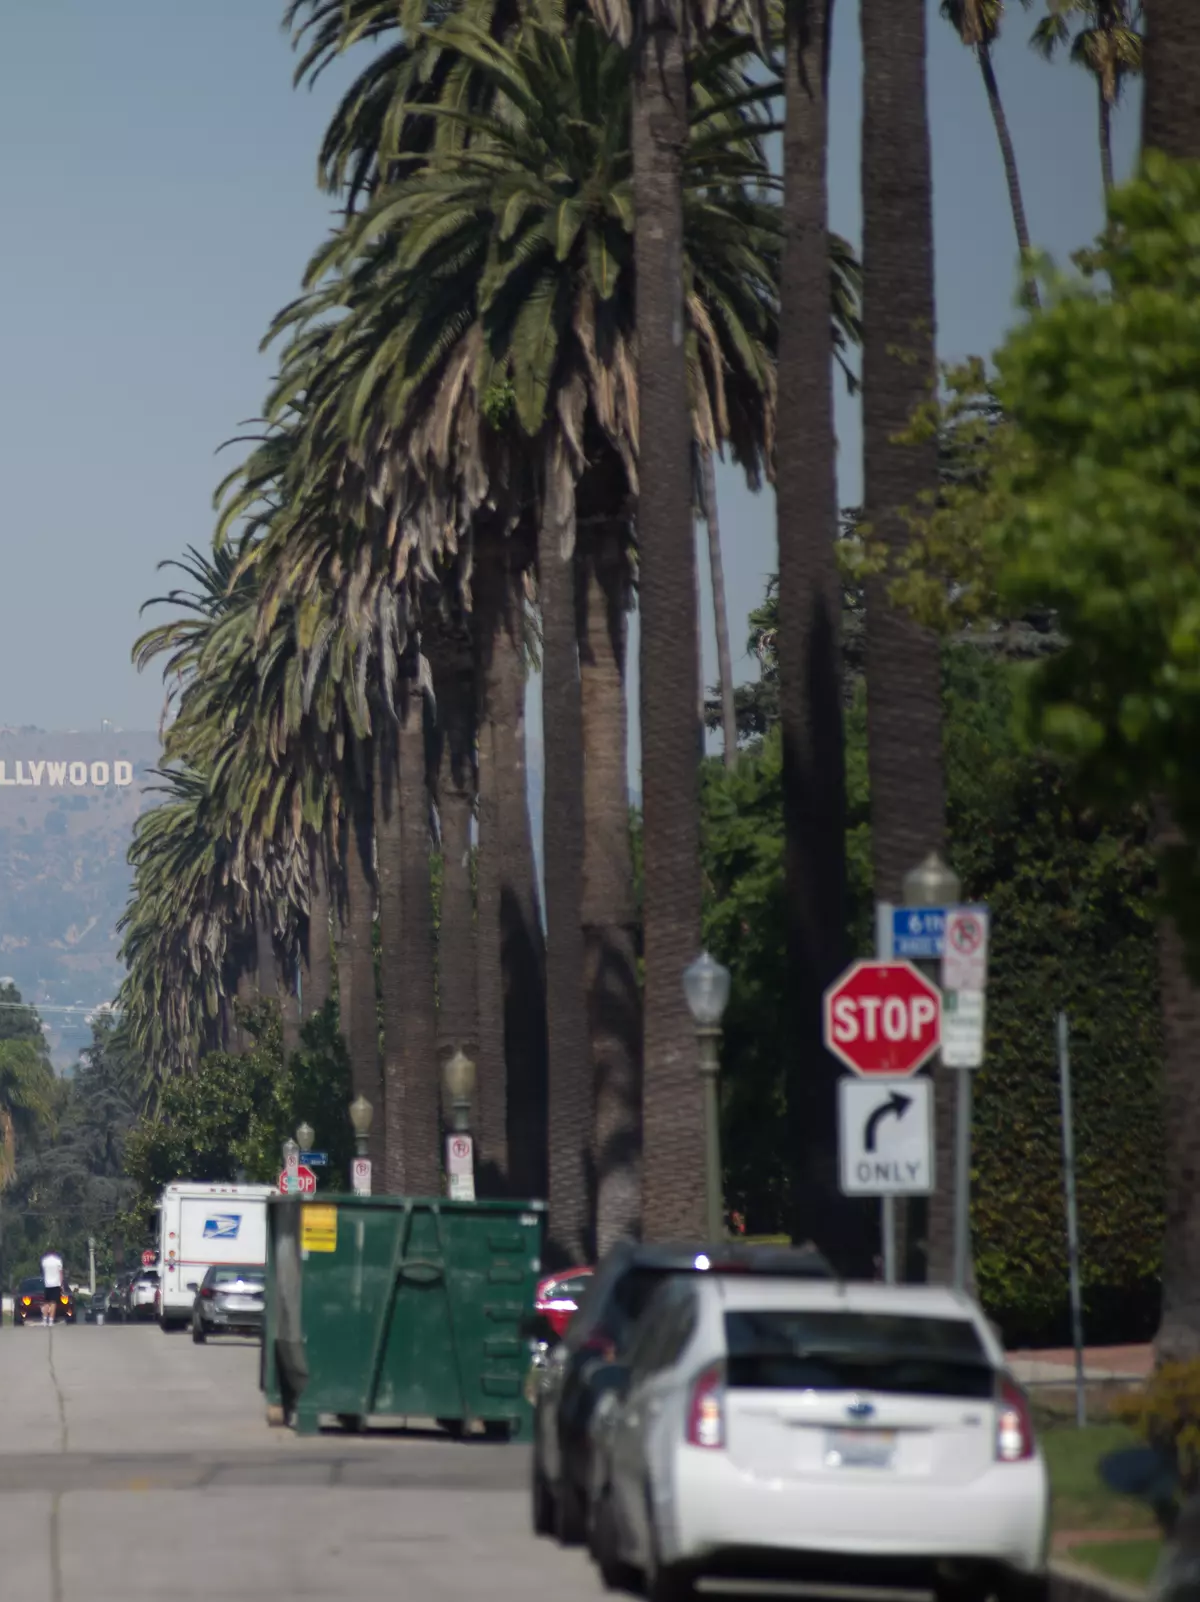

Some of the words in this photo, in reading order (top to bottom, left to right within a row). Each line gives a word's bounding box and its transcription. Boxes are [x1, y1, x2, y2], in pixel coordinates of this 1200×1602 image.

[833, 996, 936, 1042] STOP
[857, 1160, 920, 1183] ONLY
[282, 1176, 313, 1191] SOP
